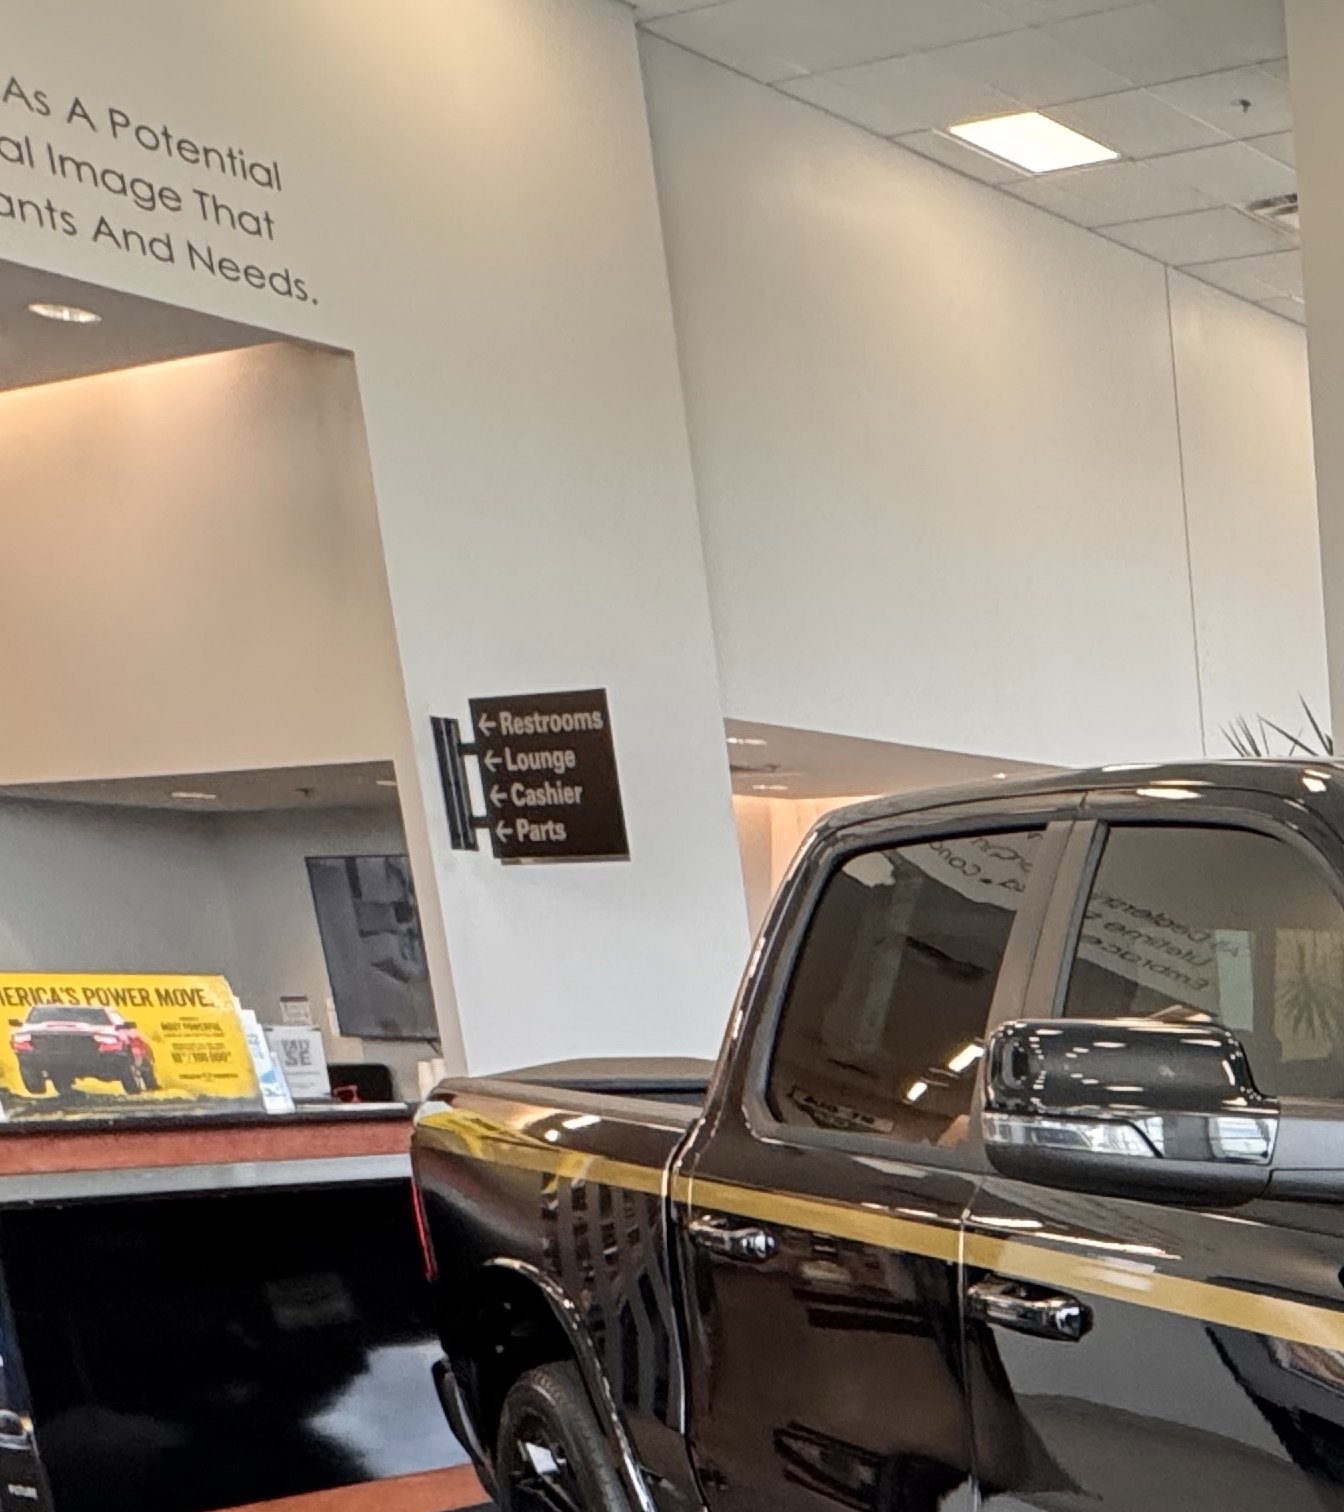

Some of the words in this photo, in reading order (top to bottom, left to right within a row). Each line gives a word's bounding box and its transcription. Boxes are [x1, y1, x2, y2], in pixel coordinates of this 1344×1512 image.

[2, 76, 50, 116] As
[67, 97, 98, 132] A
[108, 107, 282, 191] Potential
[46, 143, 182, 211] Image
[192, 188, 274, 240] That
[92, 216, 175, 264] And
[186, 240, 319, 305] Needs.
[500, 710, 604, 736] Restrooms
[504, 746, 577, 775] Lounge
[510, 780, 583, 807] Cashier
[516, 818, 567, 843] Parts
[81, 987, 150, 1007] POWER
[154, 988, 215, 1008] MOVE.
